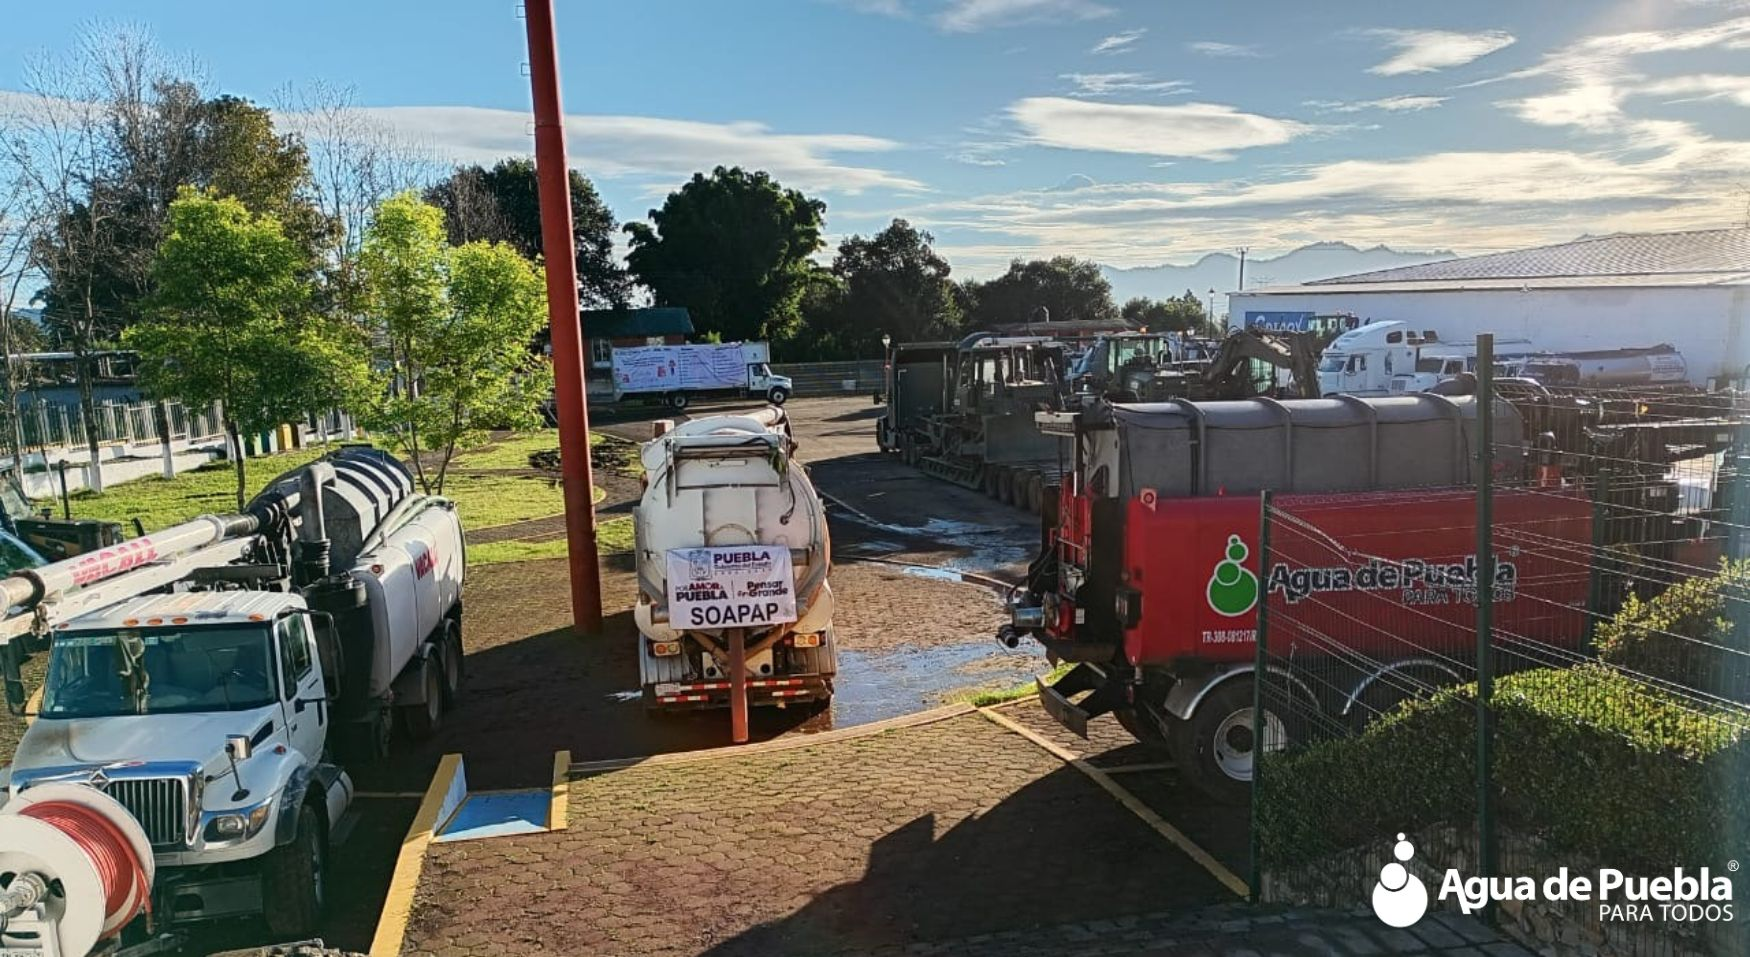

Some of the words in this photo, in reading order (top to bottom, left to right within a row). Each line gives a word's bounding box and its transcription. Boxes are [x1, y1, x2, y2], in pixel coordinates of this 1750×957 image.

[713, 551, 771, 564] PUEBLA
[689, 582, 720, 591] AMOR
[747, 580, 783, 591] Pensar
[1268, 562, 1352, 604] Agua
[1354, 558, 1400, 590] de
[676, 590, 729, 602] PUEBLA
[748, 587, 788, 597] Grande
[1402, 588, 1449, 605] PARA
[1452, 587, 1516, 604] TOOS
[691, 603, 779, 626] SOAPAP
